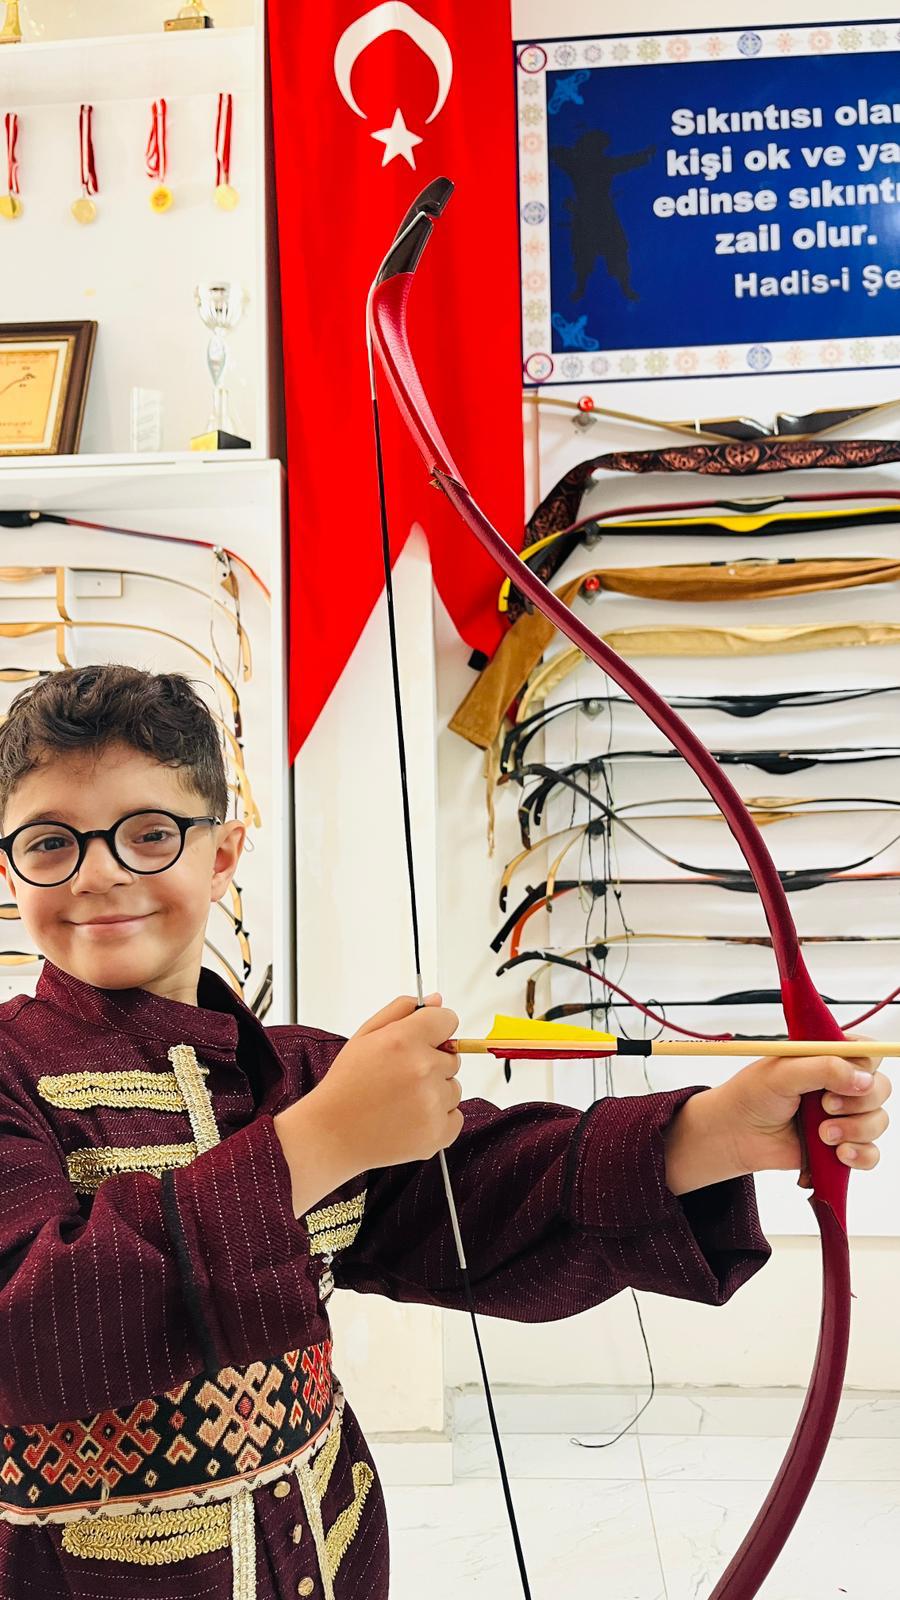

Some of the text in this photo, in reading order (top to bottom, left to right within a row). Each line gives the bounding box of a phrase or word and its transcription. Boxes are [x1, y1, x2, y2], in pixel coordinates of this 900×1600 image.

[672, 105, 822, 136] Sıkıntısı
[666, 146, 732, 181] kişi
[744, 143, 791, 171] ok
[801, 145, 847, 168] ve
[653, 188, 777, 218] edinse
[715, 221, 877, 254] zail olur.
[734, 267, 850, 298] Hadis-i
